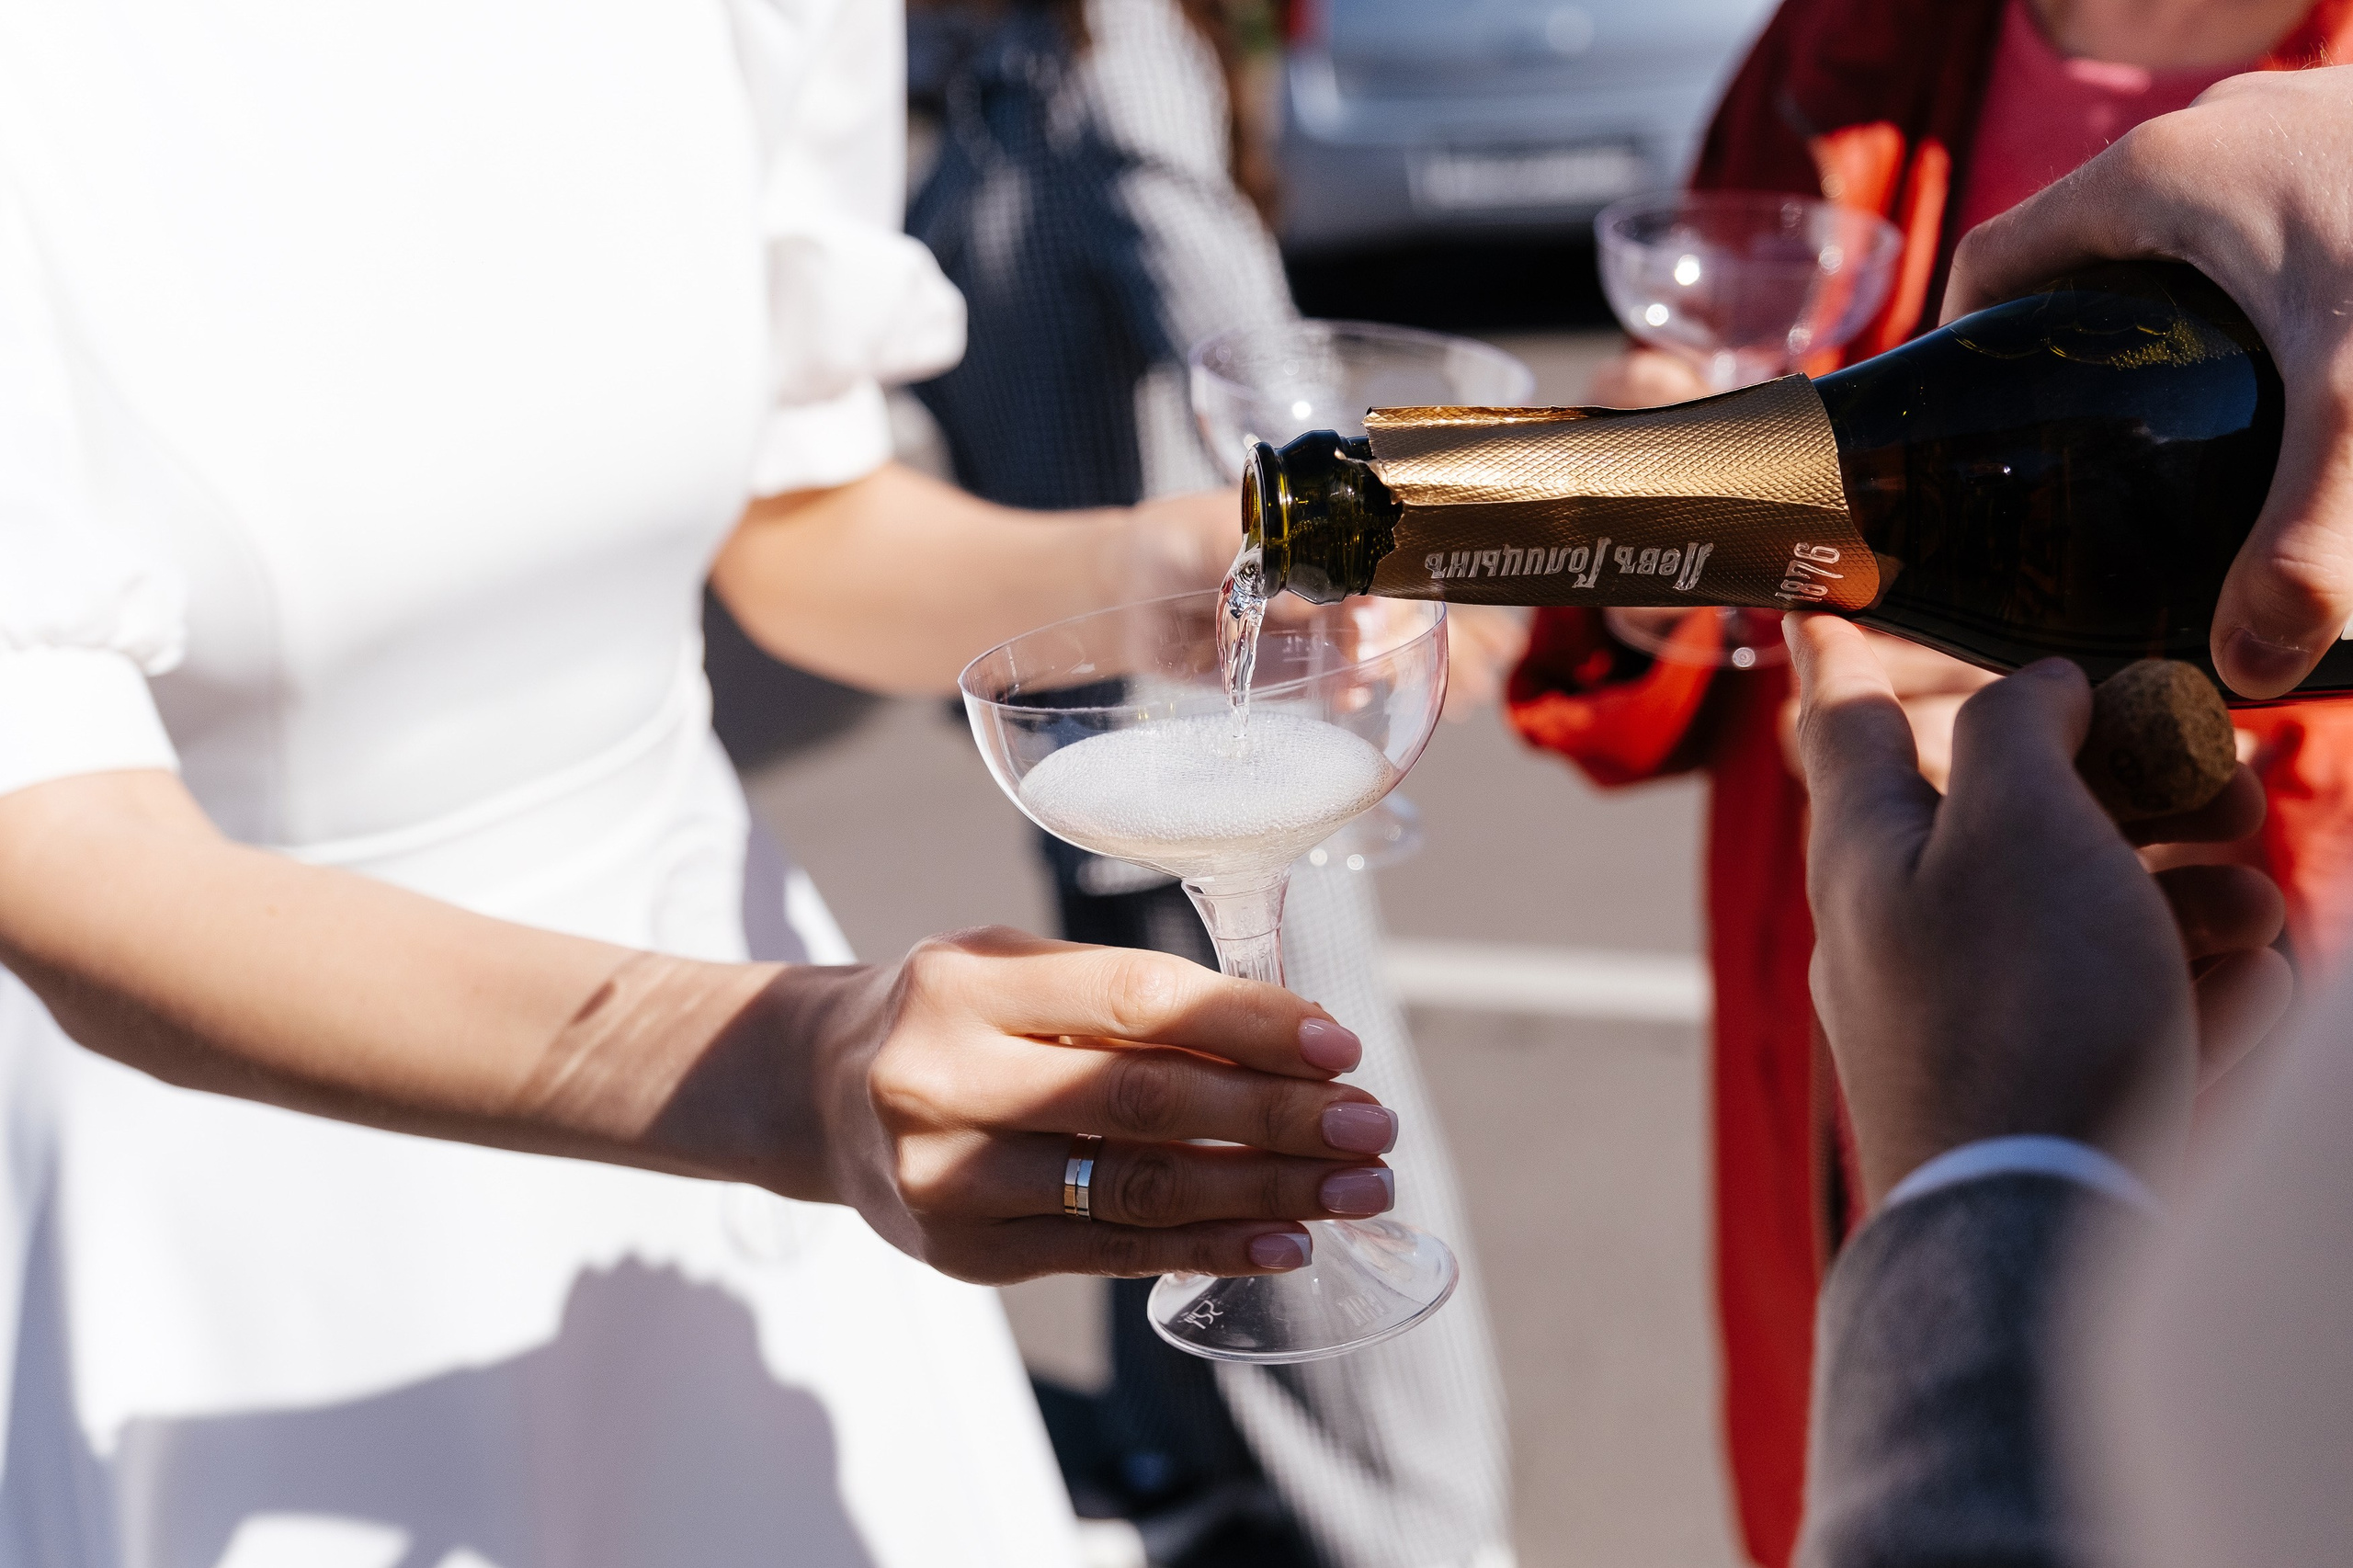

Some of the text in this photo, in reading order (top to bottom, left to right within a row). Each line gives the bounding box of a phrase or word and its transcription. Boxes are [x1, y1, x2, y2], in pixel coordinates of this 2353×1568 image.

[1424, 537, 1714, 590] Левъ Голицынъ
[1774, 541, 1845, 602] 1876
